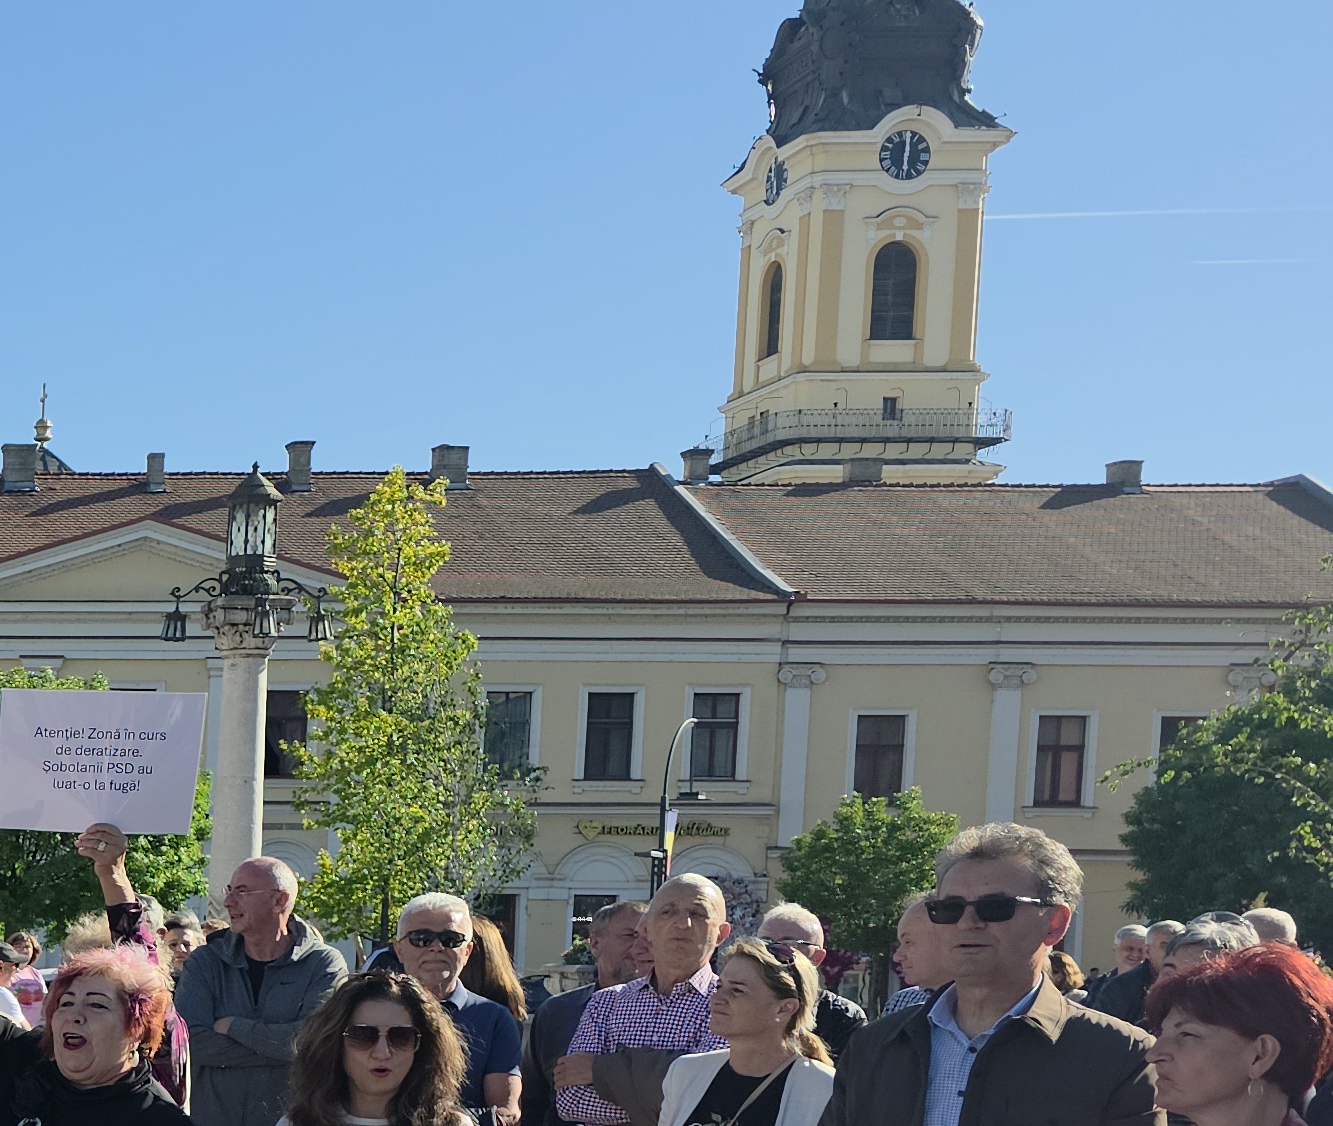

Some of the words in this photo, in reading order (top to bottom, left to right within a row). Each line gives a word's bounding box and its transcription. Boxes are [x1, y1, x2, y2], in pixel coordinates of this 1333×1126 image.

[87, 727, 121, 741] Zonă
[123, 728, 135, 741] în
[138, 731, 167, 742] curs
[55, 744, 72, 756] de
[75, 744, 143, 758] deratizare.
[106, 762, 135, 775] PSD
[137, 764, 153, 775] au
[52, 777, 91, 791] luat-o
[94, 779, 106, 791] la
[109, 779, 141, 793] fugă!
